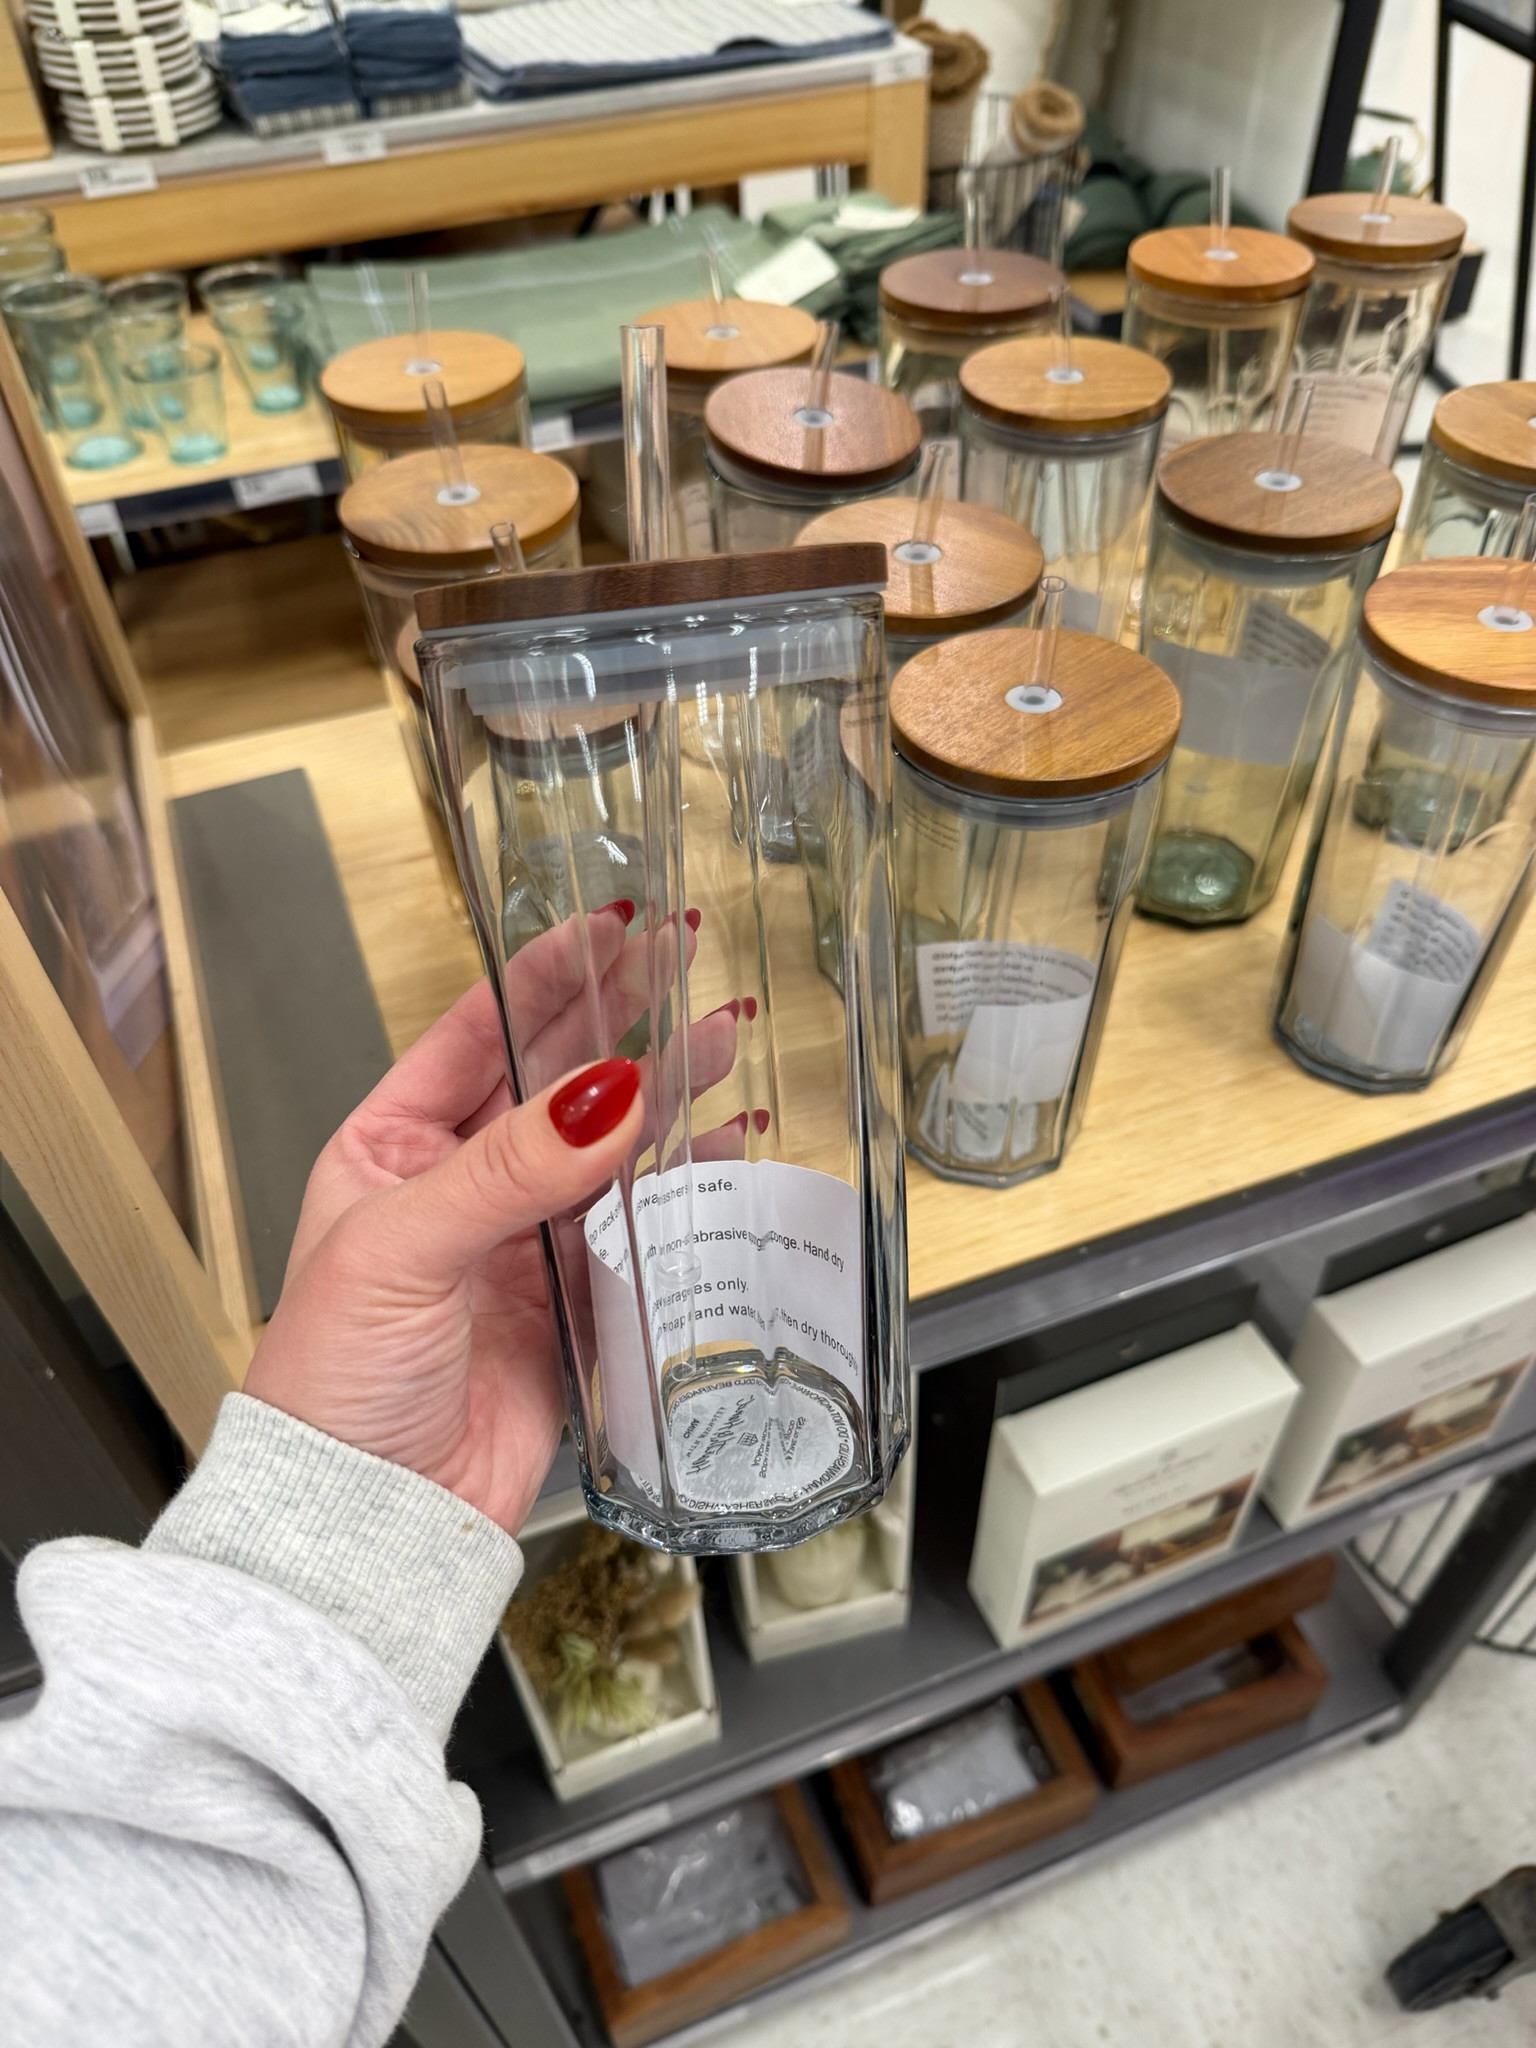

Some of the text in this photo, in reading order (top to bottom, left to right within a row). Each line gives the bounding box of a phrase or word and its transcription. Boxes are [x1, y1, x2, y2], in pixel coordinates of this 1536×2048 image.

[697, 1179, 737, 1193] safe.
[803, 1239, 829, 1262] Hand
[831, 1252, 845, 1273] dry
[716, 1277, 749, 1294] only.
[694, 1303, 724, 1321] and
[801, 1321, 818, 1342] dry
